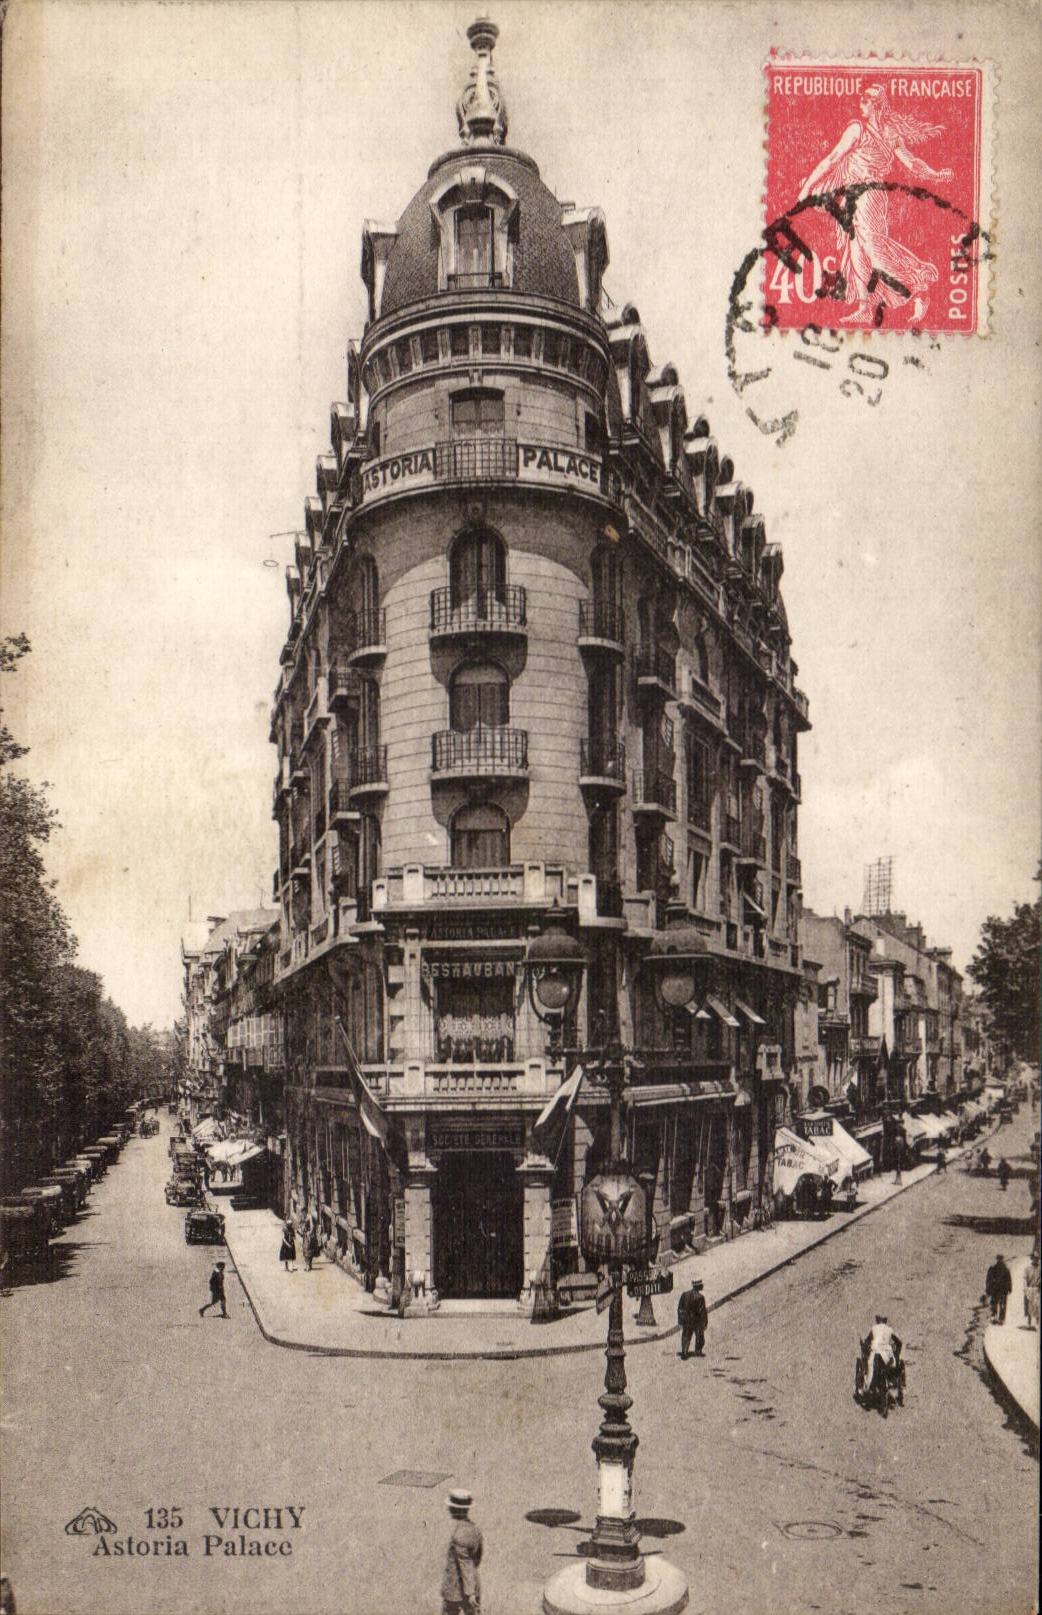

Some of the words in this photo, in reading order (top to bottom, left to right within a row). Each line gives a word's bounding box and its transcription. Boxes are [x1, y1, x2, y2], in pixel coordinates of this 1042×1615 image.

[773, 75, 862, 98] REPUBLIQUE
[890, 78, 972, 100] FRANÇAISE
[948, 232, 969, 320] POSTES
[363, 451, 433, 492] ASTORIA
[523, 450, 599, 483] PALACE
[804, 1126, 831, 1135] TABAC
[777, 1157, 805, 1170] TABAC
